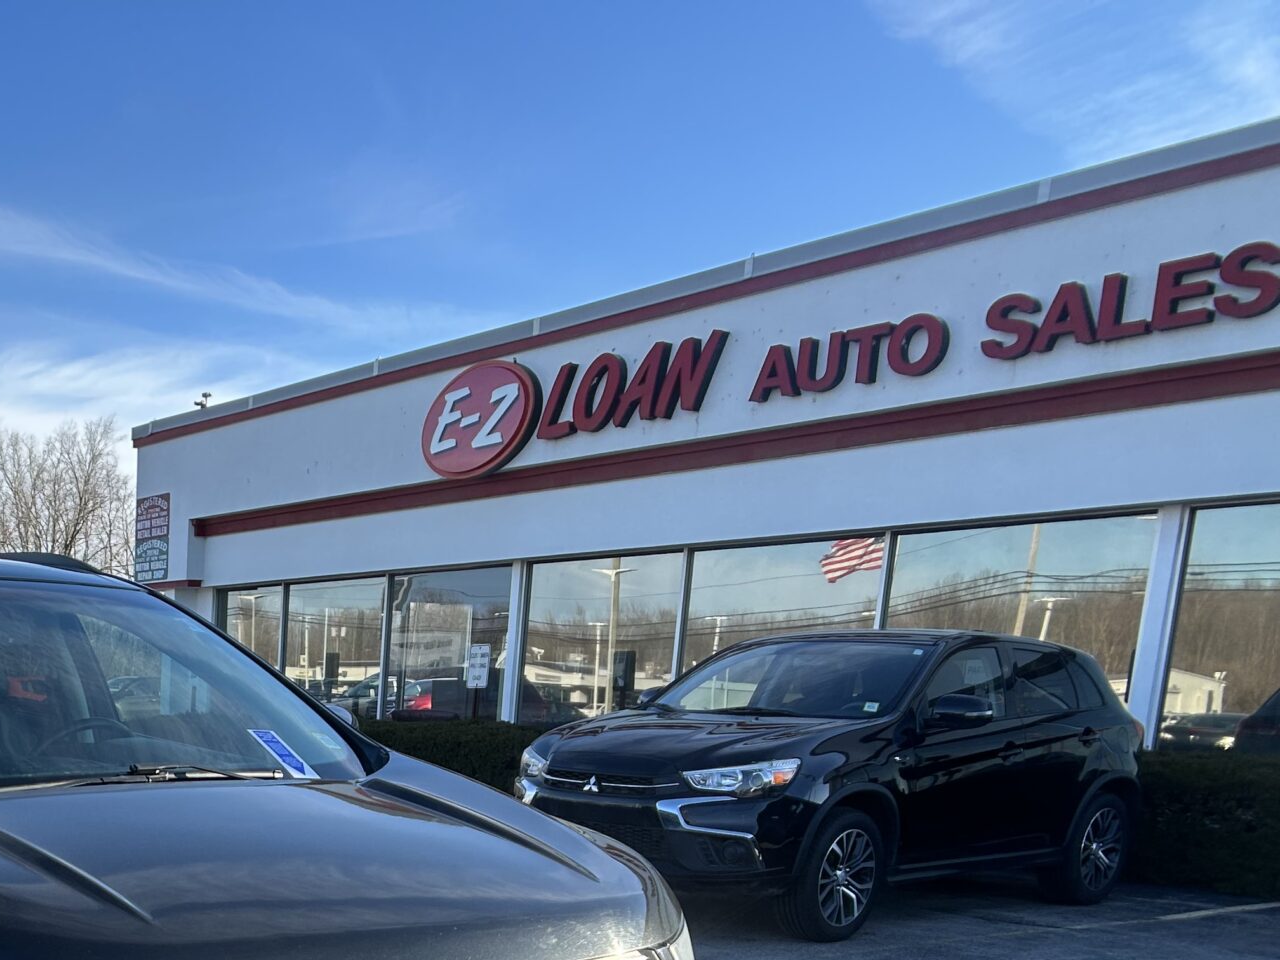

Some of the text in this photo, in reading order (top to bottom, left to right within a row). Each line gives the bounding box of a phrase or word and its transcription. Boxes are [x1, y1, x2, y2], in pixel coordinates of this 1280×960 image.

[430, 241, 1280, 454] E-Z LOAN AUTO SALES
[138, 496, 168, 515] REGISTERED
[152, 516, 168, 527] VEHICLE
[152, 526, 167, 537] DEALER
[137, 540, 167, 555] REGISTERED
[136, 559, 167, 571] MOTOR VEHICLE
[137, 571, 151, 580] REPAIR
